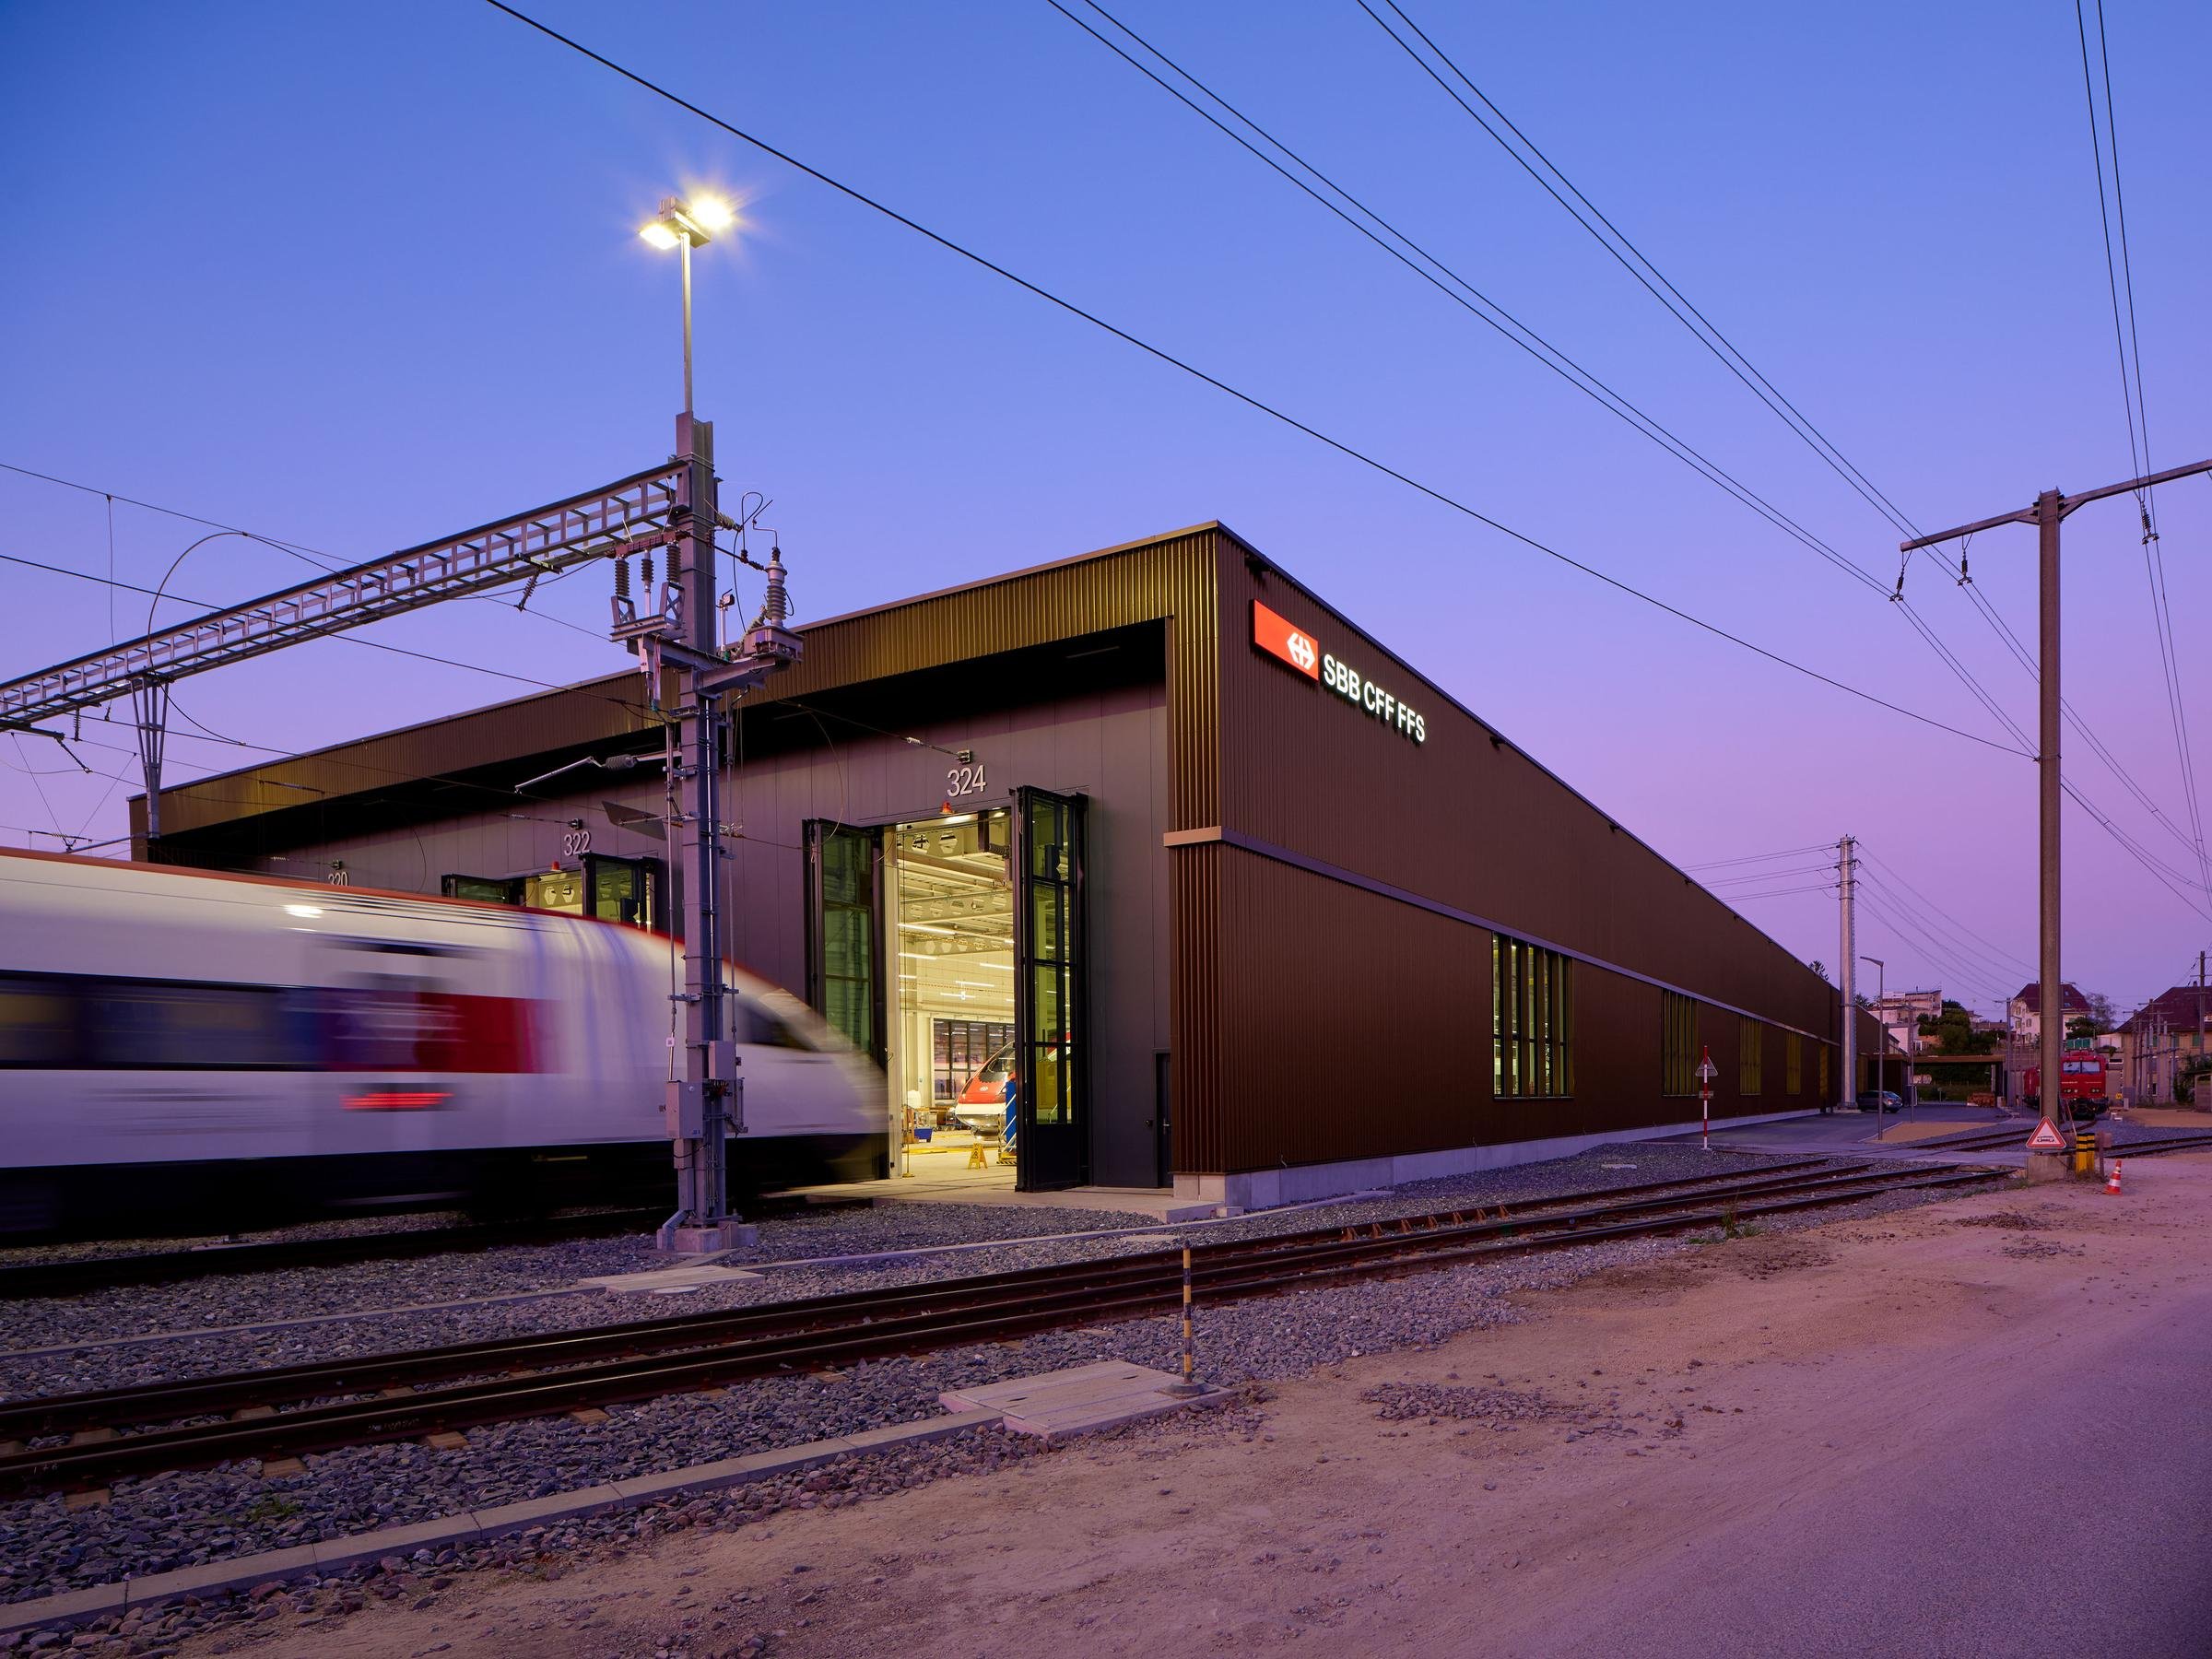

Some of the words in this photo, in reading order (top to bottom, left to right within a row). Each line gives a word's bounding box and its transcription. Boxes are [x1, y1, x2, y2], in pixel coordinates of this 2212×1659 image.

[1324, 653, 1360, 701] SBB
[1364, 681, 1394, 721] CFF
[1397, 701, 1426, 743] FFS
[947, 764, 986, 797] 324
[564, 830, 590, 856] 322
